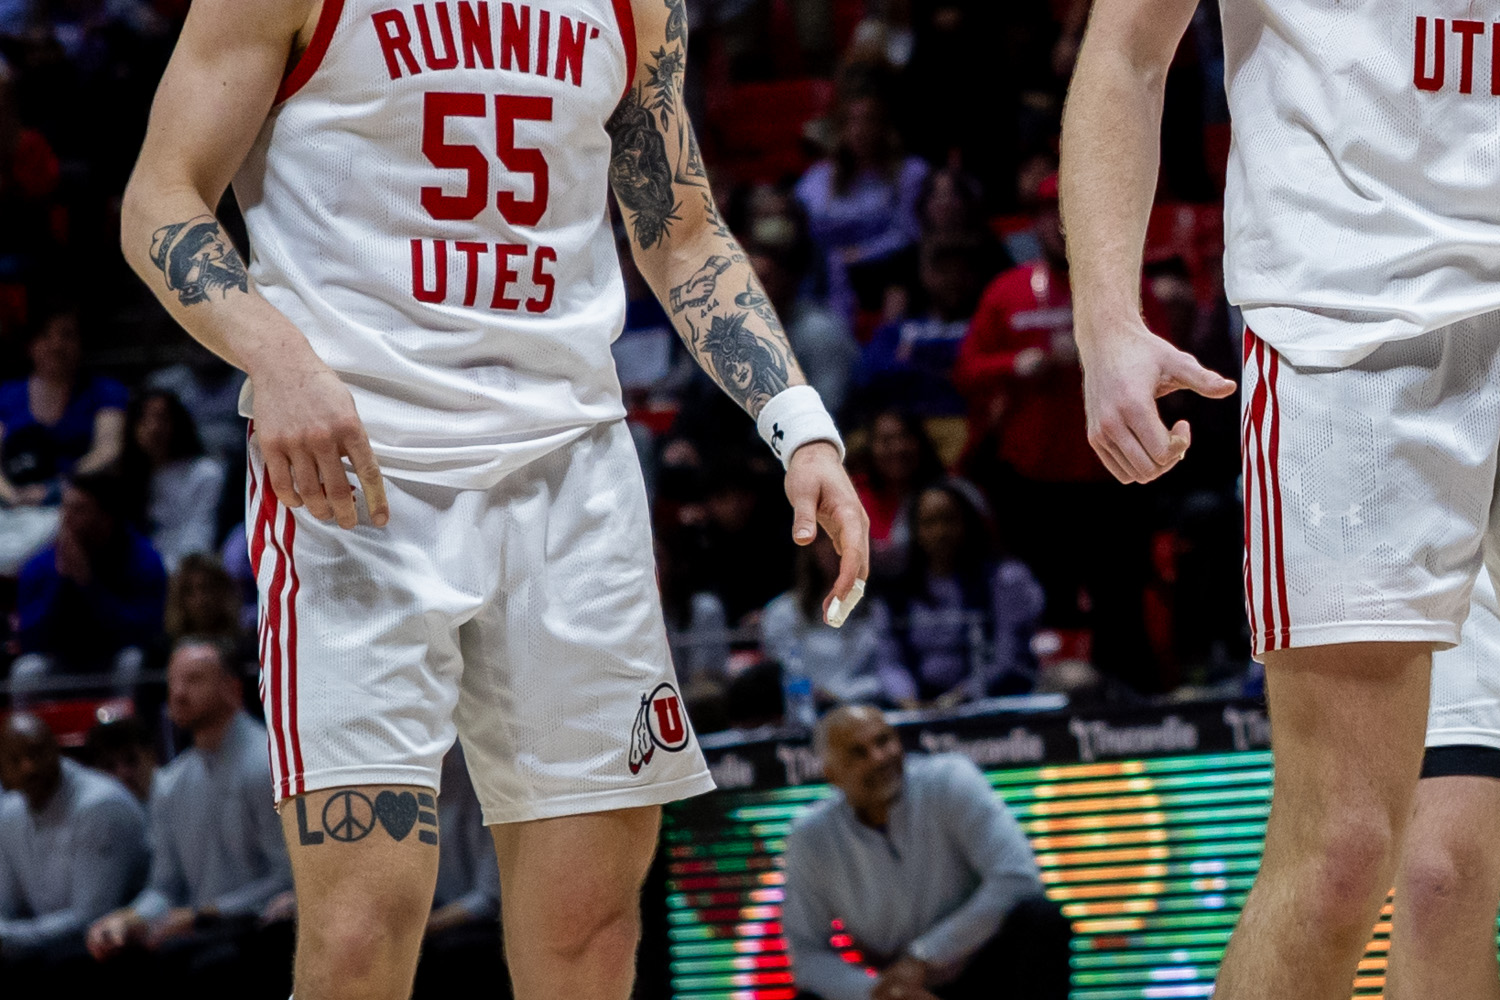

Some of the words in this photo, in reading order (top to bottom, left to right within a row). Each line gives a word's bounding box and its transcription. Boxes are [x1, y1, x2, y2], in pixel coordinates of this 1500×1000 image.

[371, 0, 600, 87] RUNNIN'
[420, 91, 553, 227] 55
[410, 238, 558, 313] UTES
[653, 696, 684, 744] U
